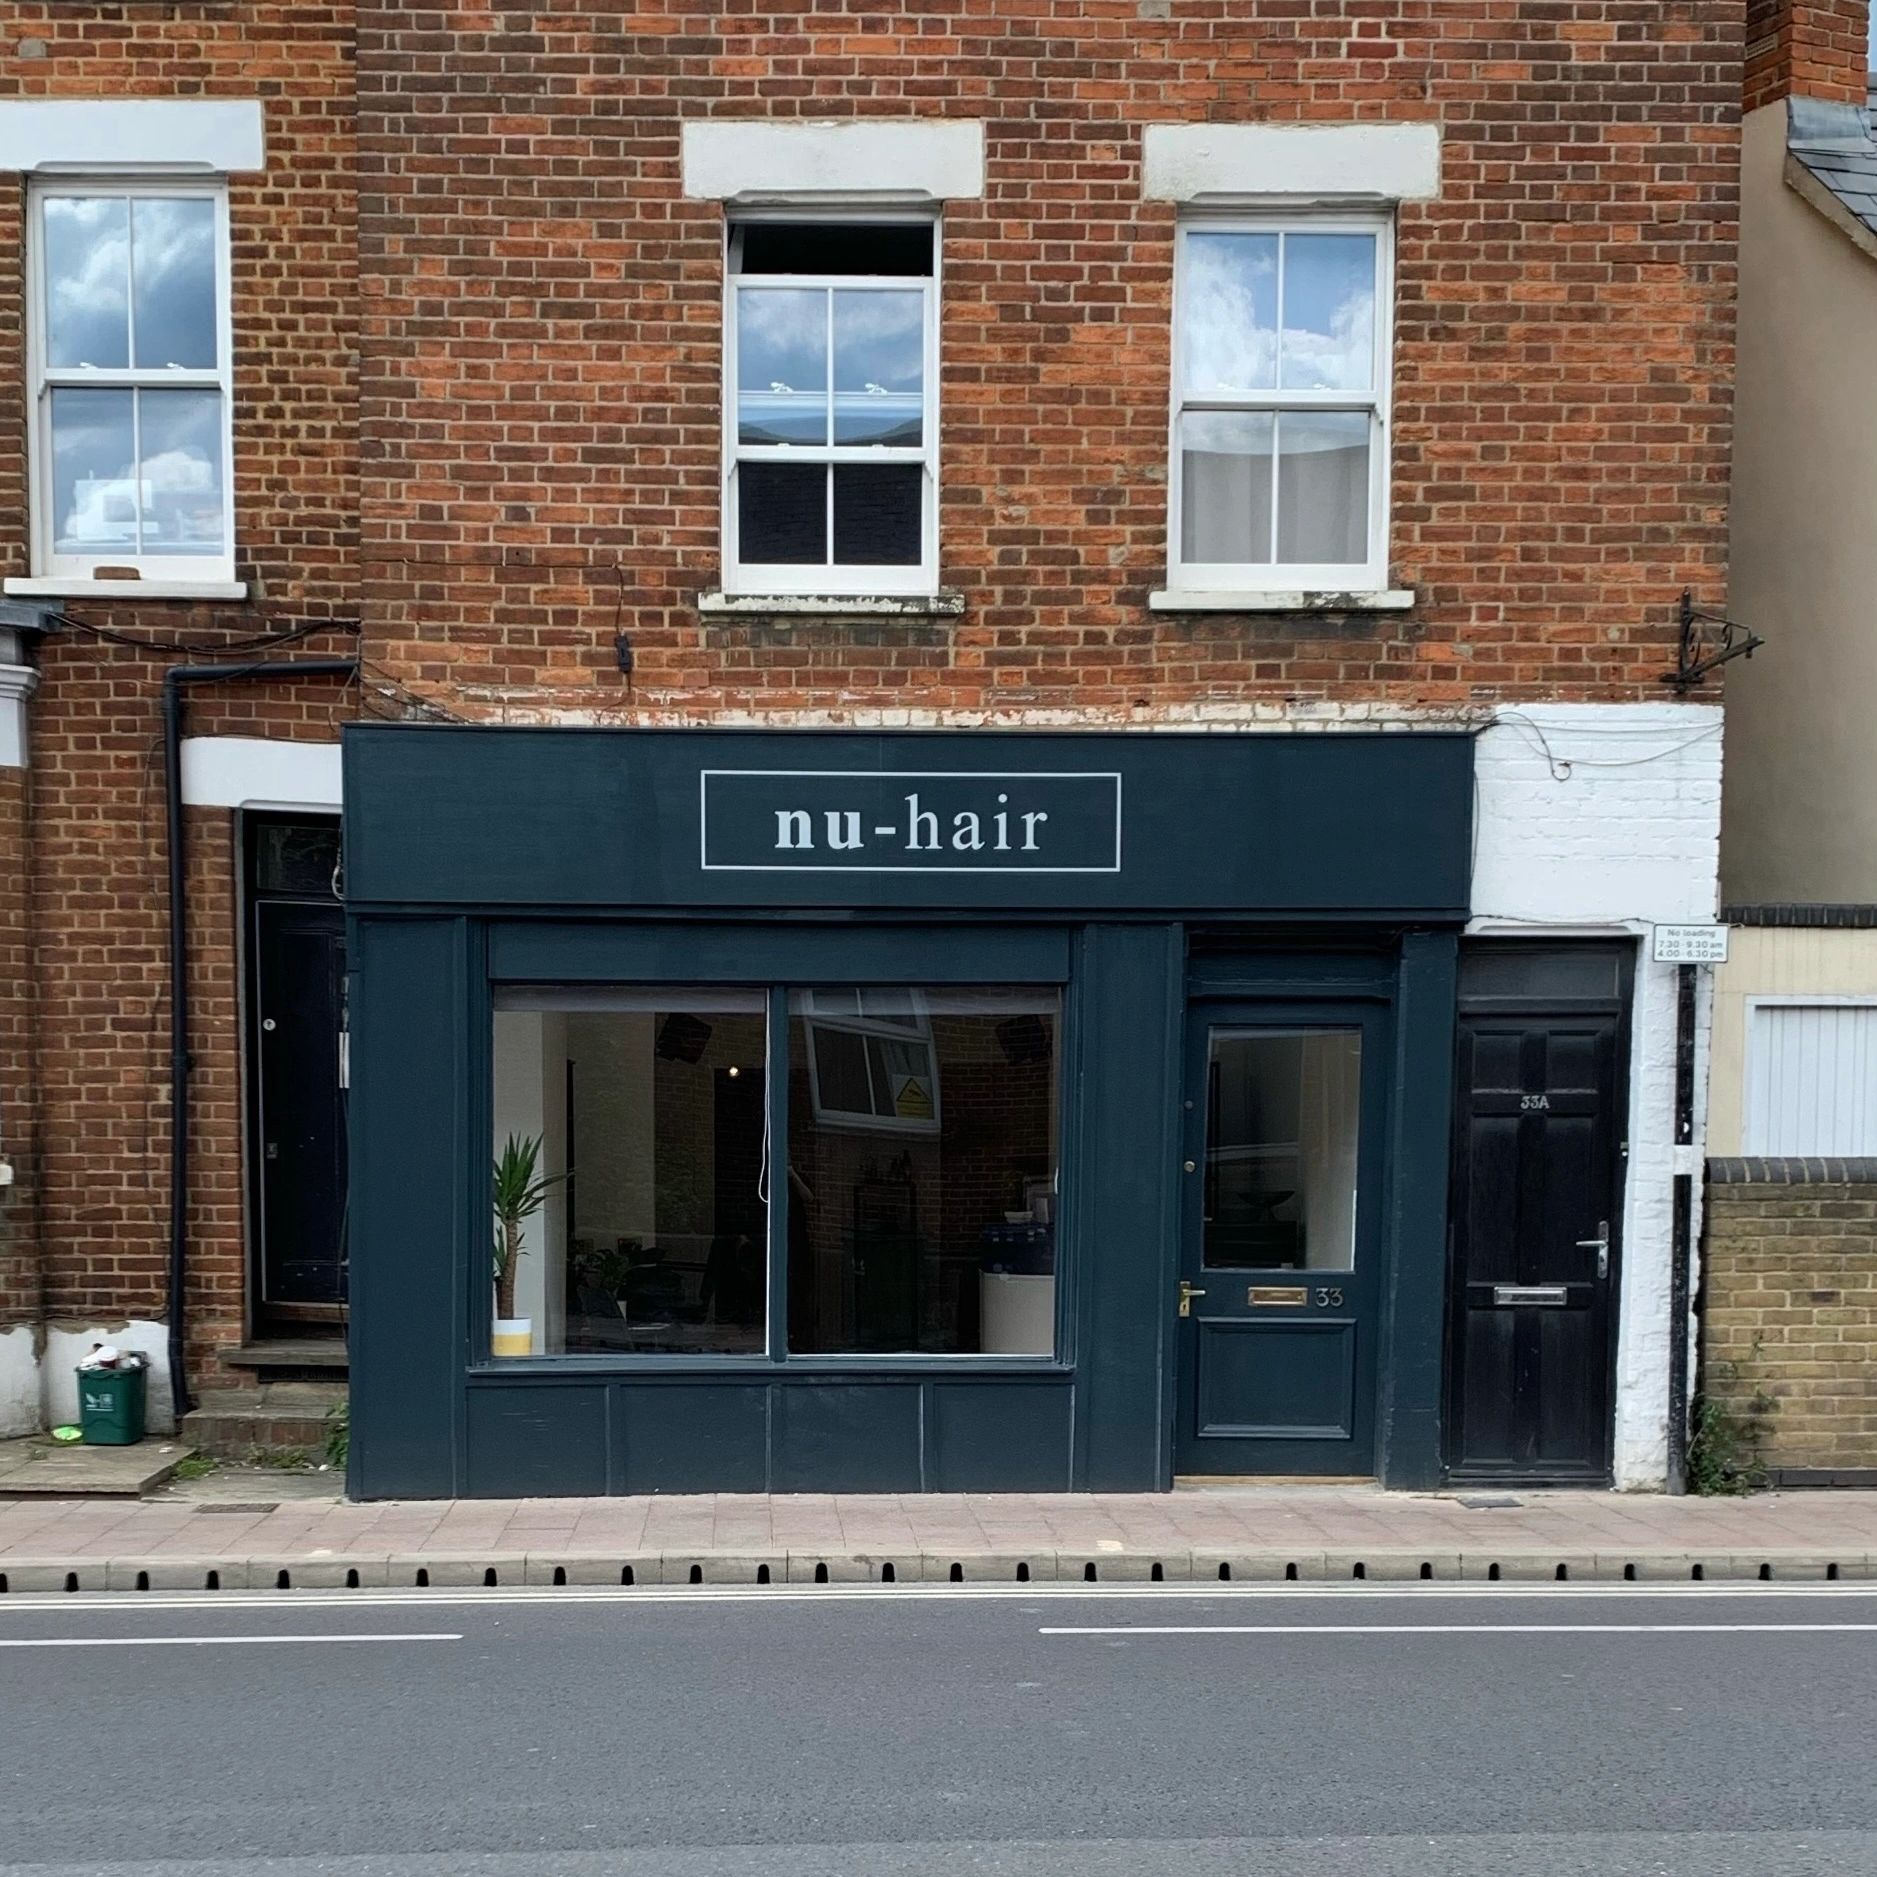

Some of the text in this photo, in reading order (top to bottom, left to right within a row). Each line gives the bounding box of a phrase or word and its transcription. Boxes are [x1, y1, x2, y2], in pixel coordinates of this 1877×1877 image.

[774, 793, 1049, 851] nu-hair
[1667, 929, 1716, 938] No loading
[1686, 940, 1708, 949] 9.30
[1687, 949, 1708, 958] 6.30
[1710, 951, 1724, 959] pm
[1520, 1095, 1550, 1110] 33A
[1315, 1287, 1344, 1307] 33
